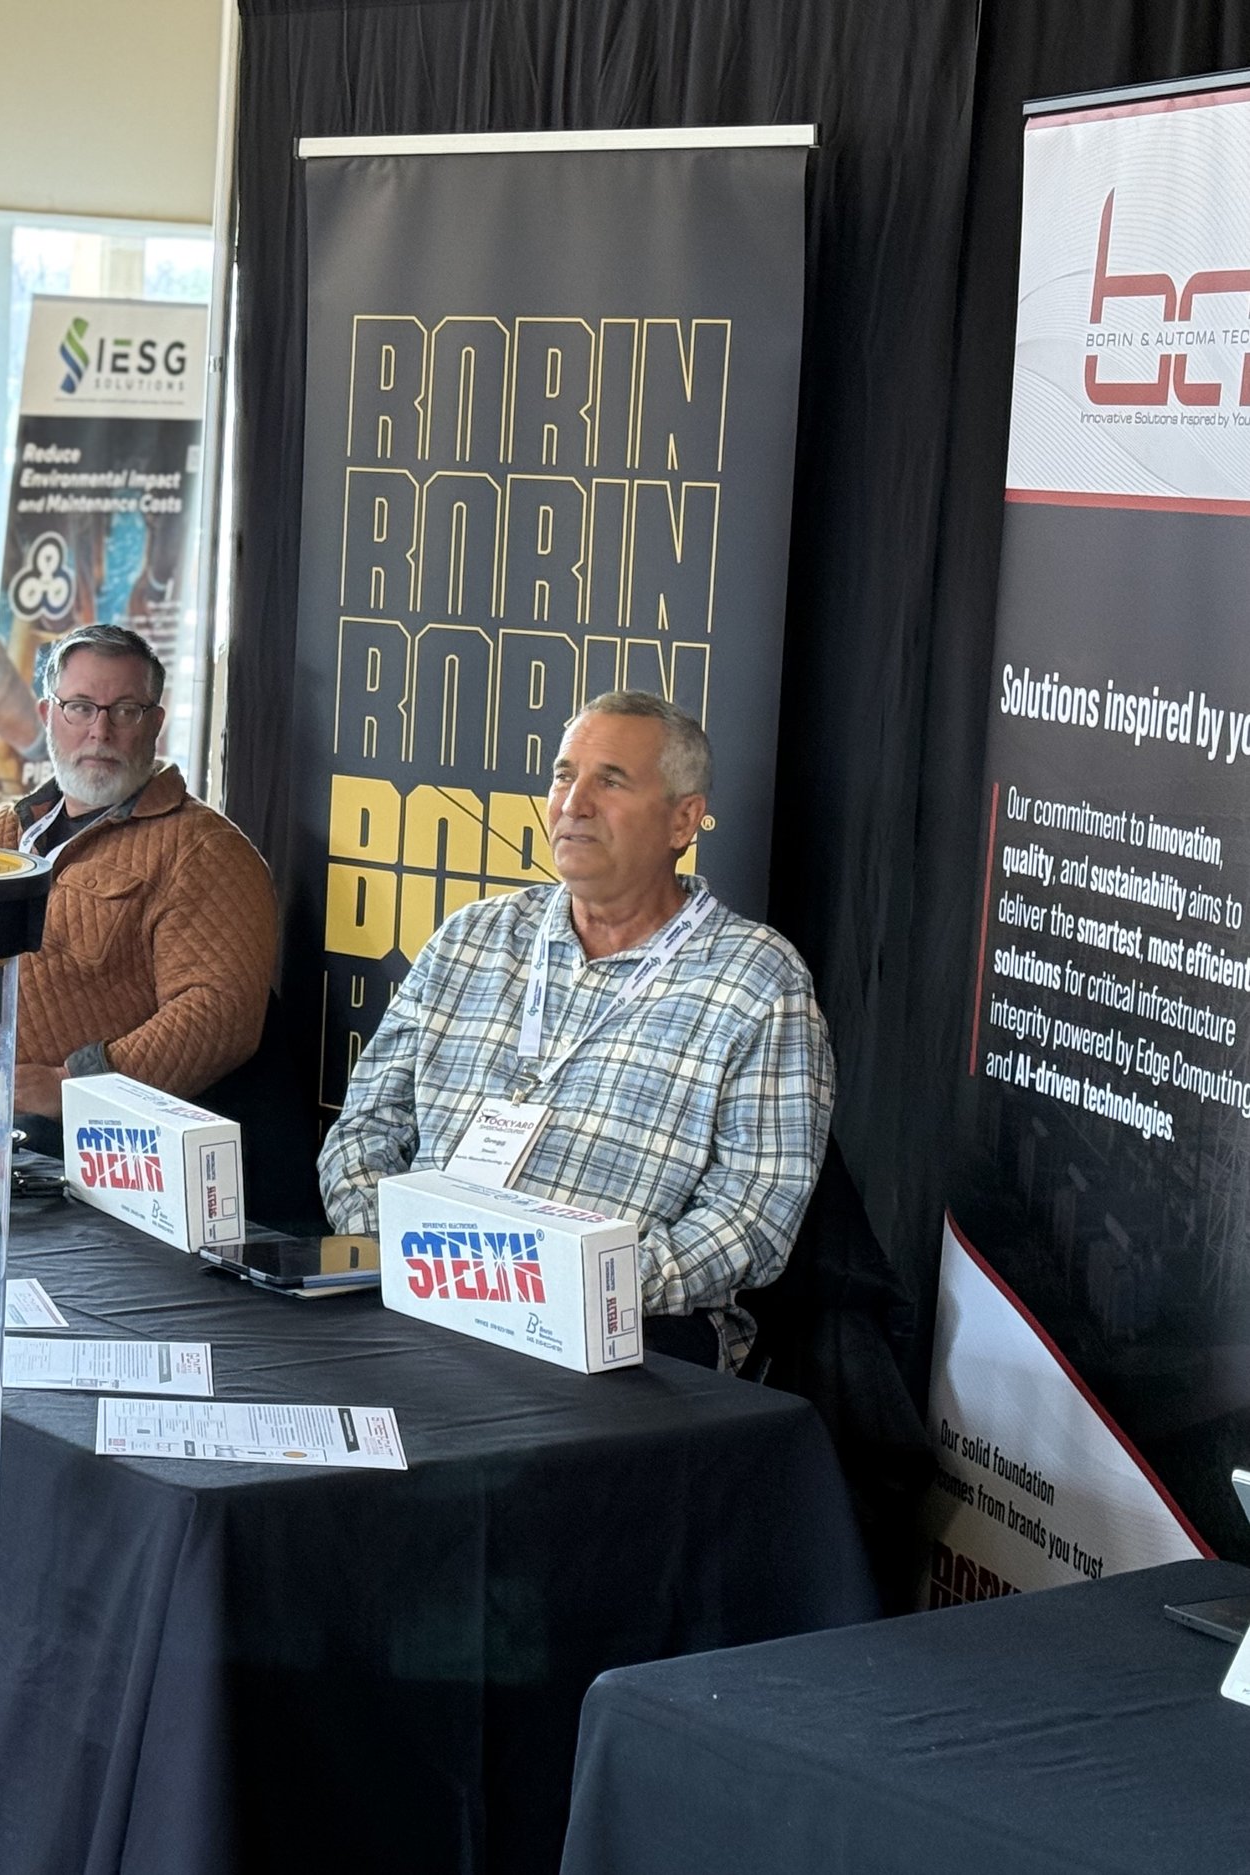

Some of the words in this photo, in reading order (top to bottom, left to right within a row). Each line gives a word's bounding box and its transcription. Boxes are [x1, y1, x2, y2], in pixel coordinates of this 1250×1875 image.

[97, 338, 186, 375] IESG
[1086, 333, 1133, 347] BORIN
[1140, 333, 1151, 347] &
[1155, 331, 1216, 346] AUTOMA
[95, 379, 184, 392] SOLUTIONS
[1080, 411, 1132, 425] Innovative
[1134, 412, 1178, 426] Solutions
[1180, 412, 1216, 427] Inspired
[1218, 413, 1230, 429] by
[20, 468, 126, 488] Environmental
[128, 470, 181, 491] Impact
[23, 443, 81, 463] Reduce
[18, 497, 45, 512] and
[46, 494, 138, 512] Maintenance
[140, 495, 182, 513] Costs
[1001, 663, 1099, 728] Solutions
[1104, 679, 1194, 746] inspired
[1196, 692, 1224, 761] by
[1007, 786, 1031, 822] Our
[1034, 800, 1127, 843] commitment
[1130, 815, 1145, 847] to
[1147, 814, 1223, 870] innovation,
[1003, 843, 1056, 887] quality,
[1060, 855, 1089, 889] and
[1090, 864, 1187, 921] sustainability
[1188, 885, 1222, 924] aims
[1226, 894, 1243, 930] to
[998, 890, 1047, 932] deliver
[1051, 903, 1074, 940] the
[1077, 916, 1144, 964] smartest,
[1147, 934, 1185, 972] most
[1185, 940, 1250, 992] efficient
[994, 945, 1061, 990] solutions
[1064, 959, 1086, 997] for
[1087, 970, 1136, 1014] critical
[1138, 982, 1236, 1047] infrastructure
[986, 1050, 1013, 1082] and
[1014, 1053, 1080, 1107] AI-driven
[1083, 1077, 1175, 1142] technologies.
[990, 993, 1051, 1047] integrity
[1053, 1018, 1114, 1063] powered
[1115, 1031, 1134, 1075] by
[1136, 1037, 1170, 1087] Edge
[1172, 1050, 1250, 1118] Computing
[476, 1113, 535, 1130] STOCKYARD
[940, 1418, 960, 1453] Our
[962, 1436, 991, 1469] solid
[993, 1446, 1055, 1506] foundation
[977, 1484, 1005, 1524] from
[1008, 1500, 1047, 1549] brands
[1048, 1531, 1070, 1564] you
[1073, 1542, 1104, 1579] trust
